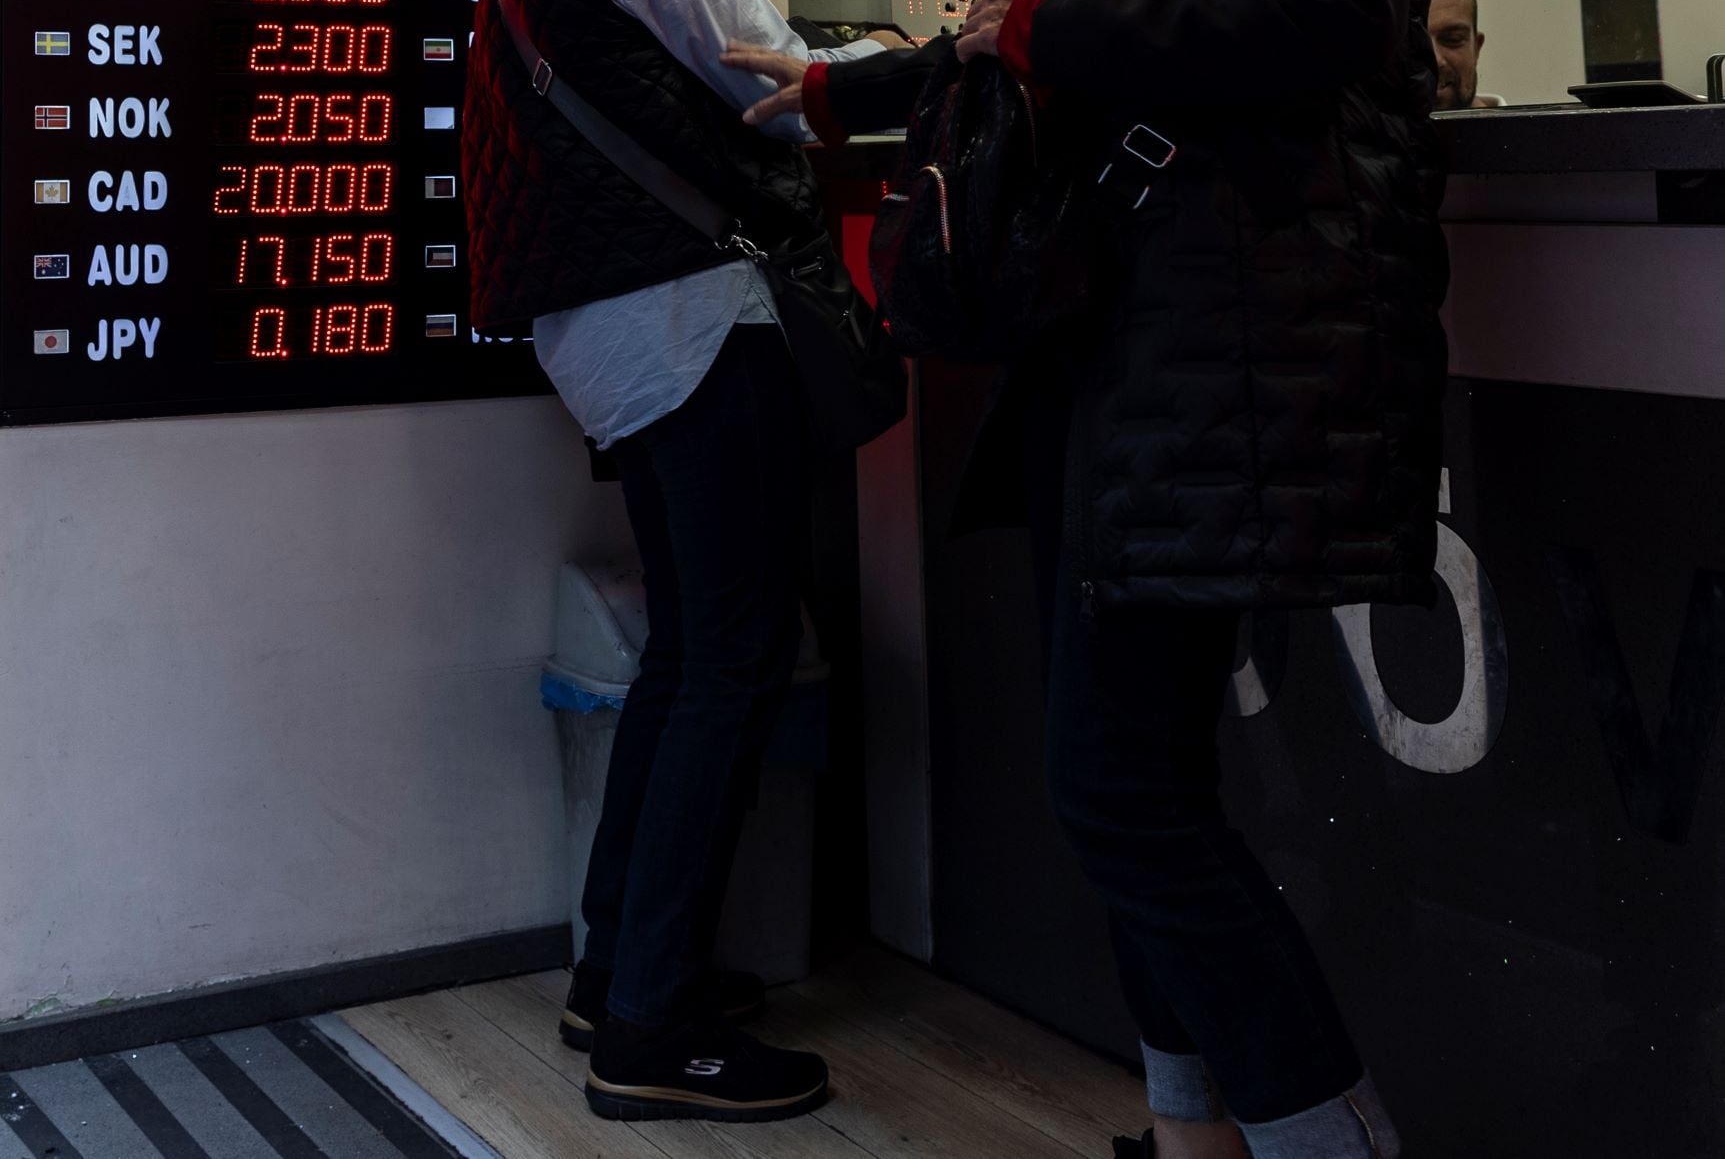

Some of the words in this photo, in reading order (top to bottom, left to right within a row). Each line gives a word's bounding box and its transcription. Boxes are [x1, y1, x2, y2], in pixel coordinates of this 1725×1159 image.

[87, 23, 163, 66] SEK
[250, 24, 391, 73] 2.300
[89, 97, 172, 139] NOK
[250, 94, 391, 143] 2.050
[87, 170, 168, 213] CAD
[213, 164, 392, 216] 20.000
[87, 243, 169, 287] AUD
[238, 233, 392, 286] 17.150
[87, 317, 161, 362] JPY
[251, 304, 393, 358] 0.180
